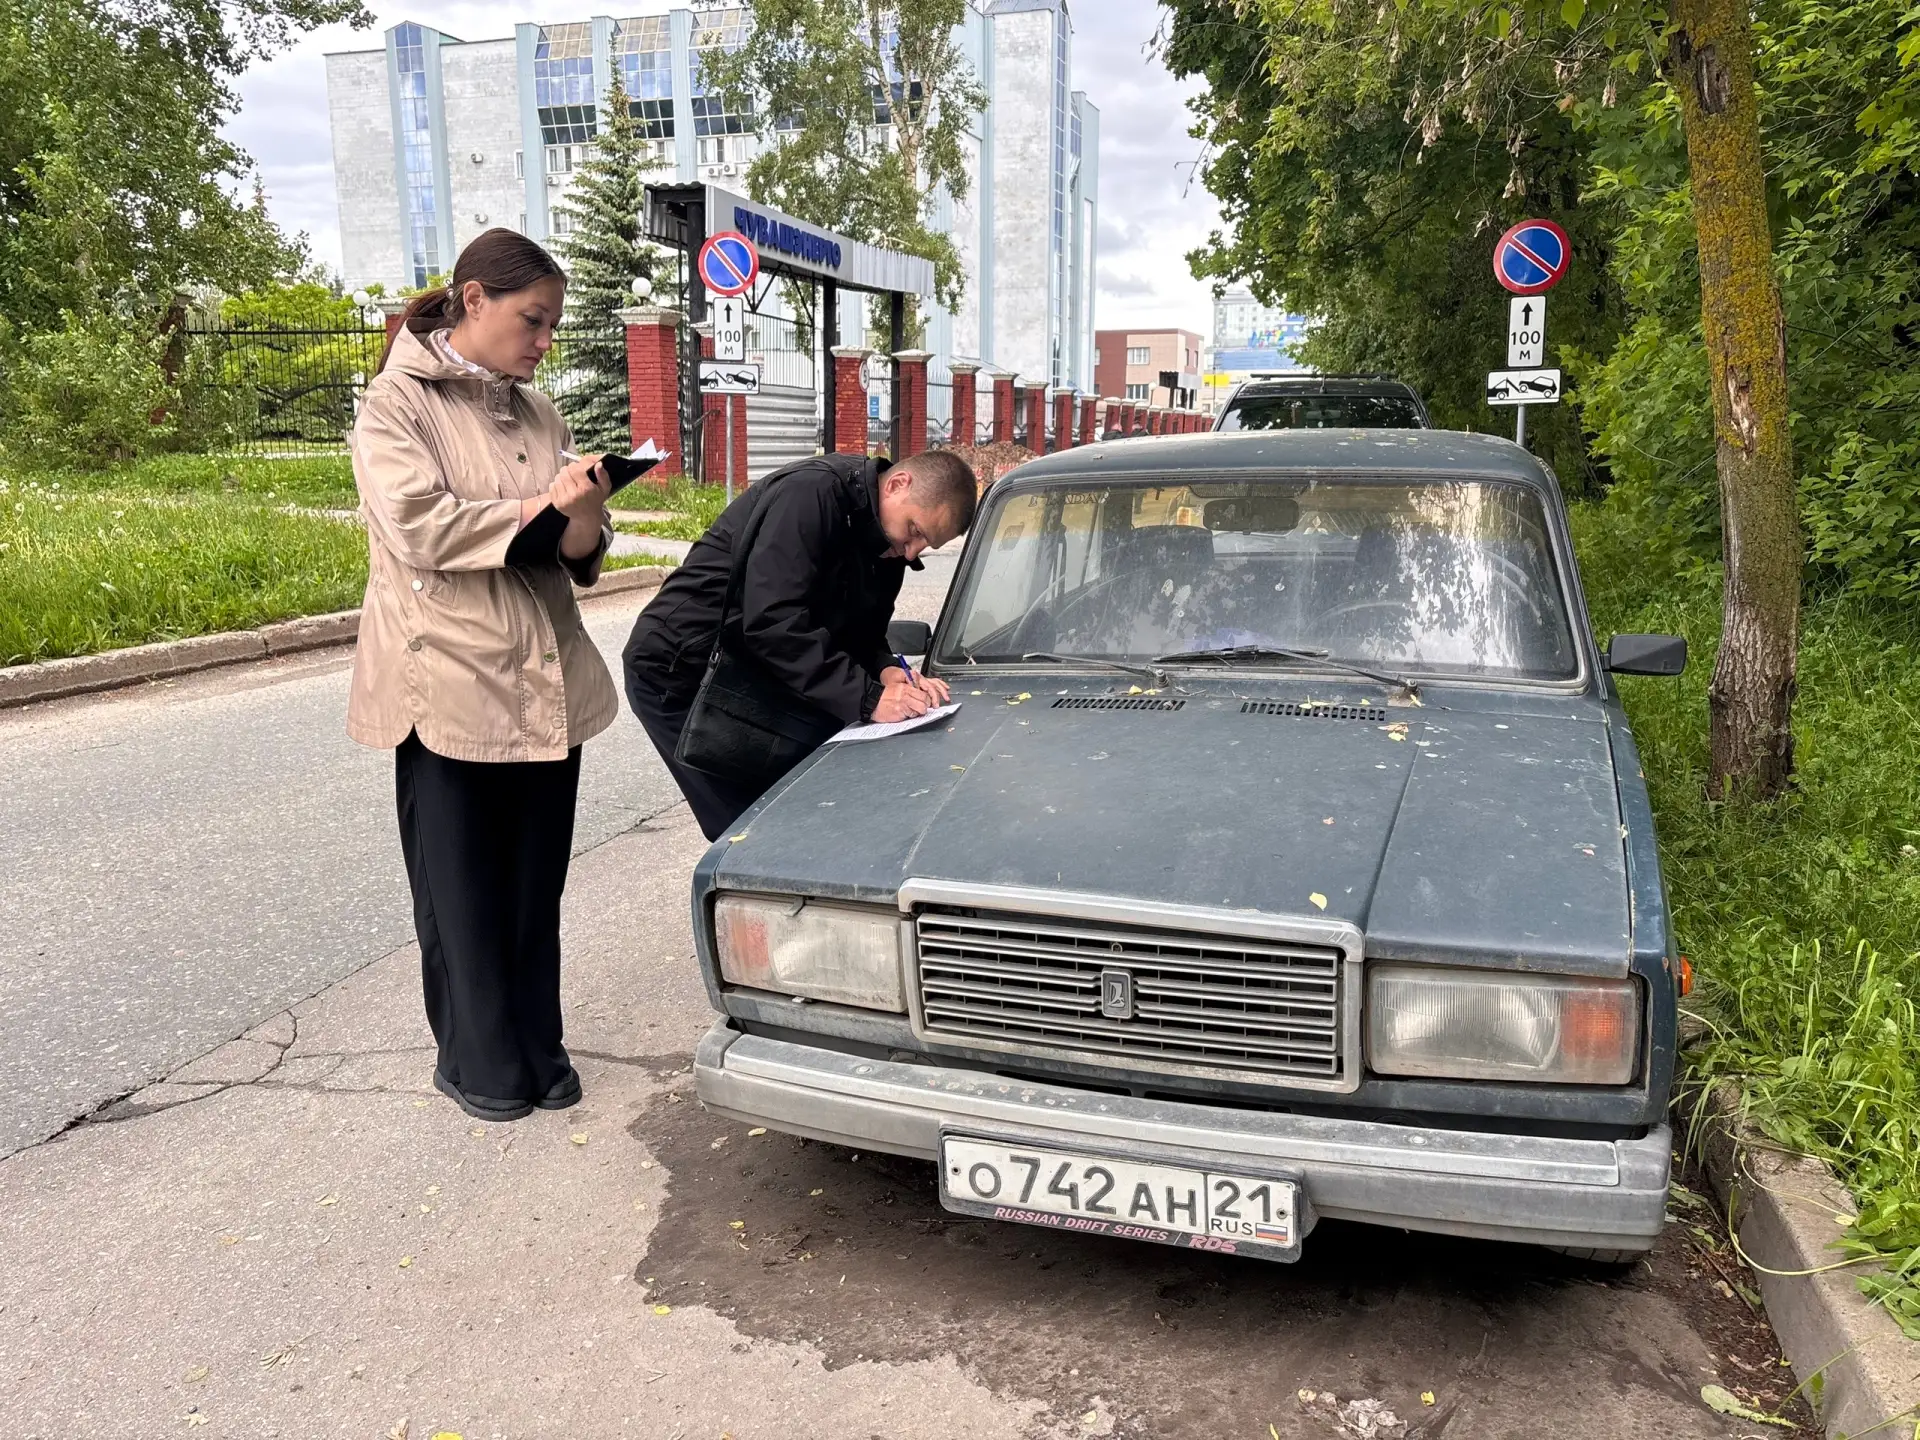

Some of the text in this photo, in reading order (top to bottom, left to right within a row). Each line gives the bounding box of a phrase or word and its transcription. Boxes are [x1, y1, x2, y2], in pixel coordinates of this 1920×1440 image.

[734, 206, 842, 268] ЧУВАШЭНЕРГО
[716, 330, 741, 343] 100
[1511, 330, 1541, 346] 100
[1213, 1179, 1271, 1223] 21
[993, 1206, 1240, 1253] RUSSIAN DRIFT SERIES RDS
[1210, 1218, 1253, 1236] RUS
